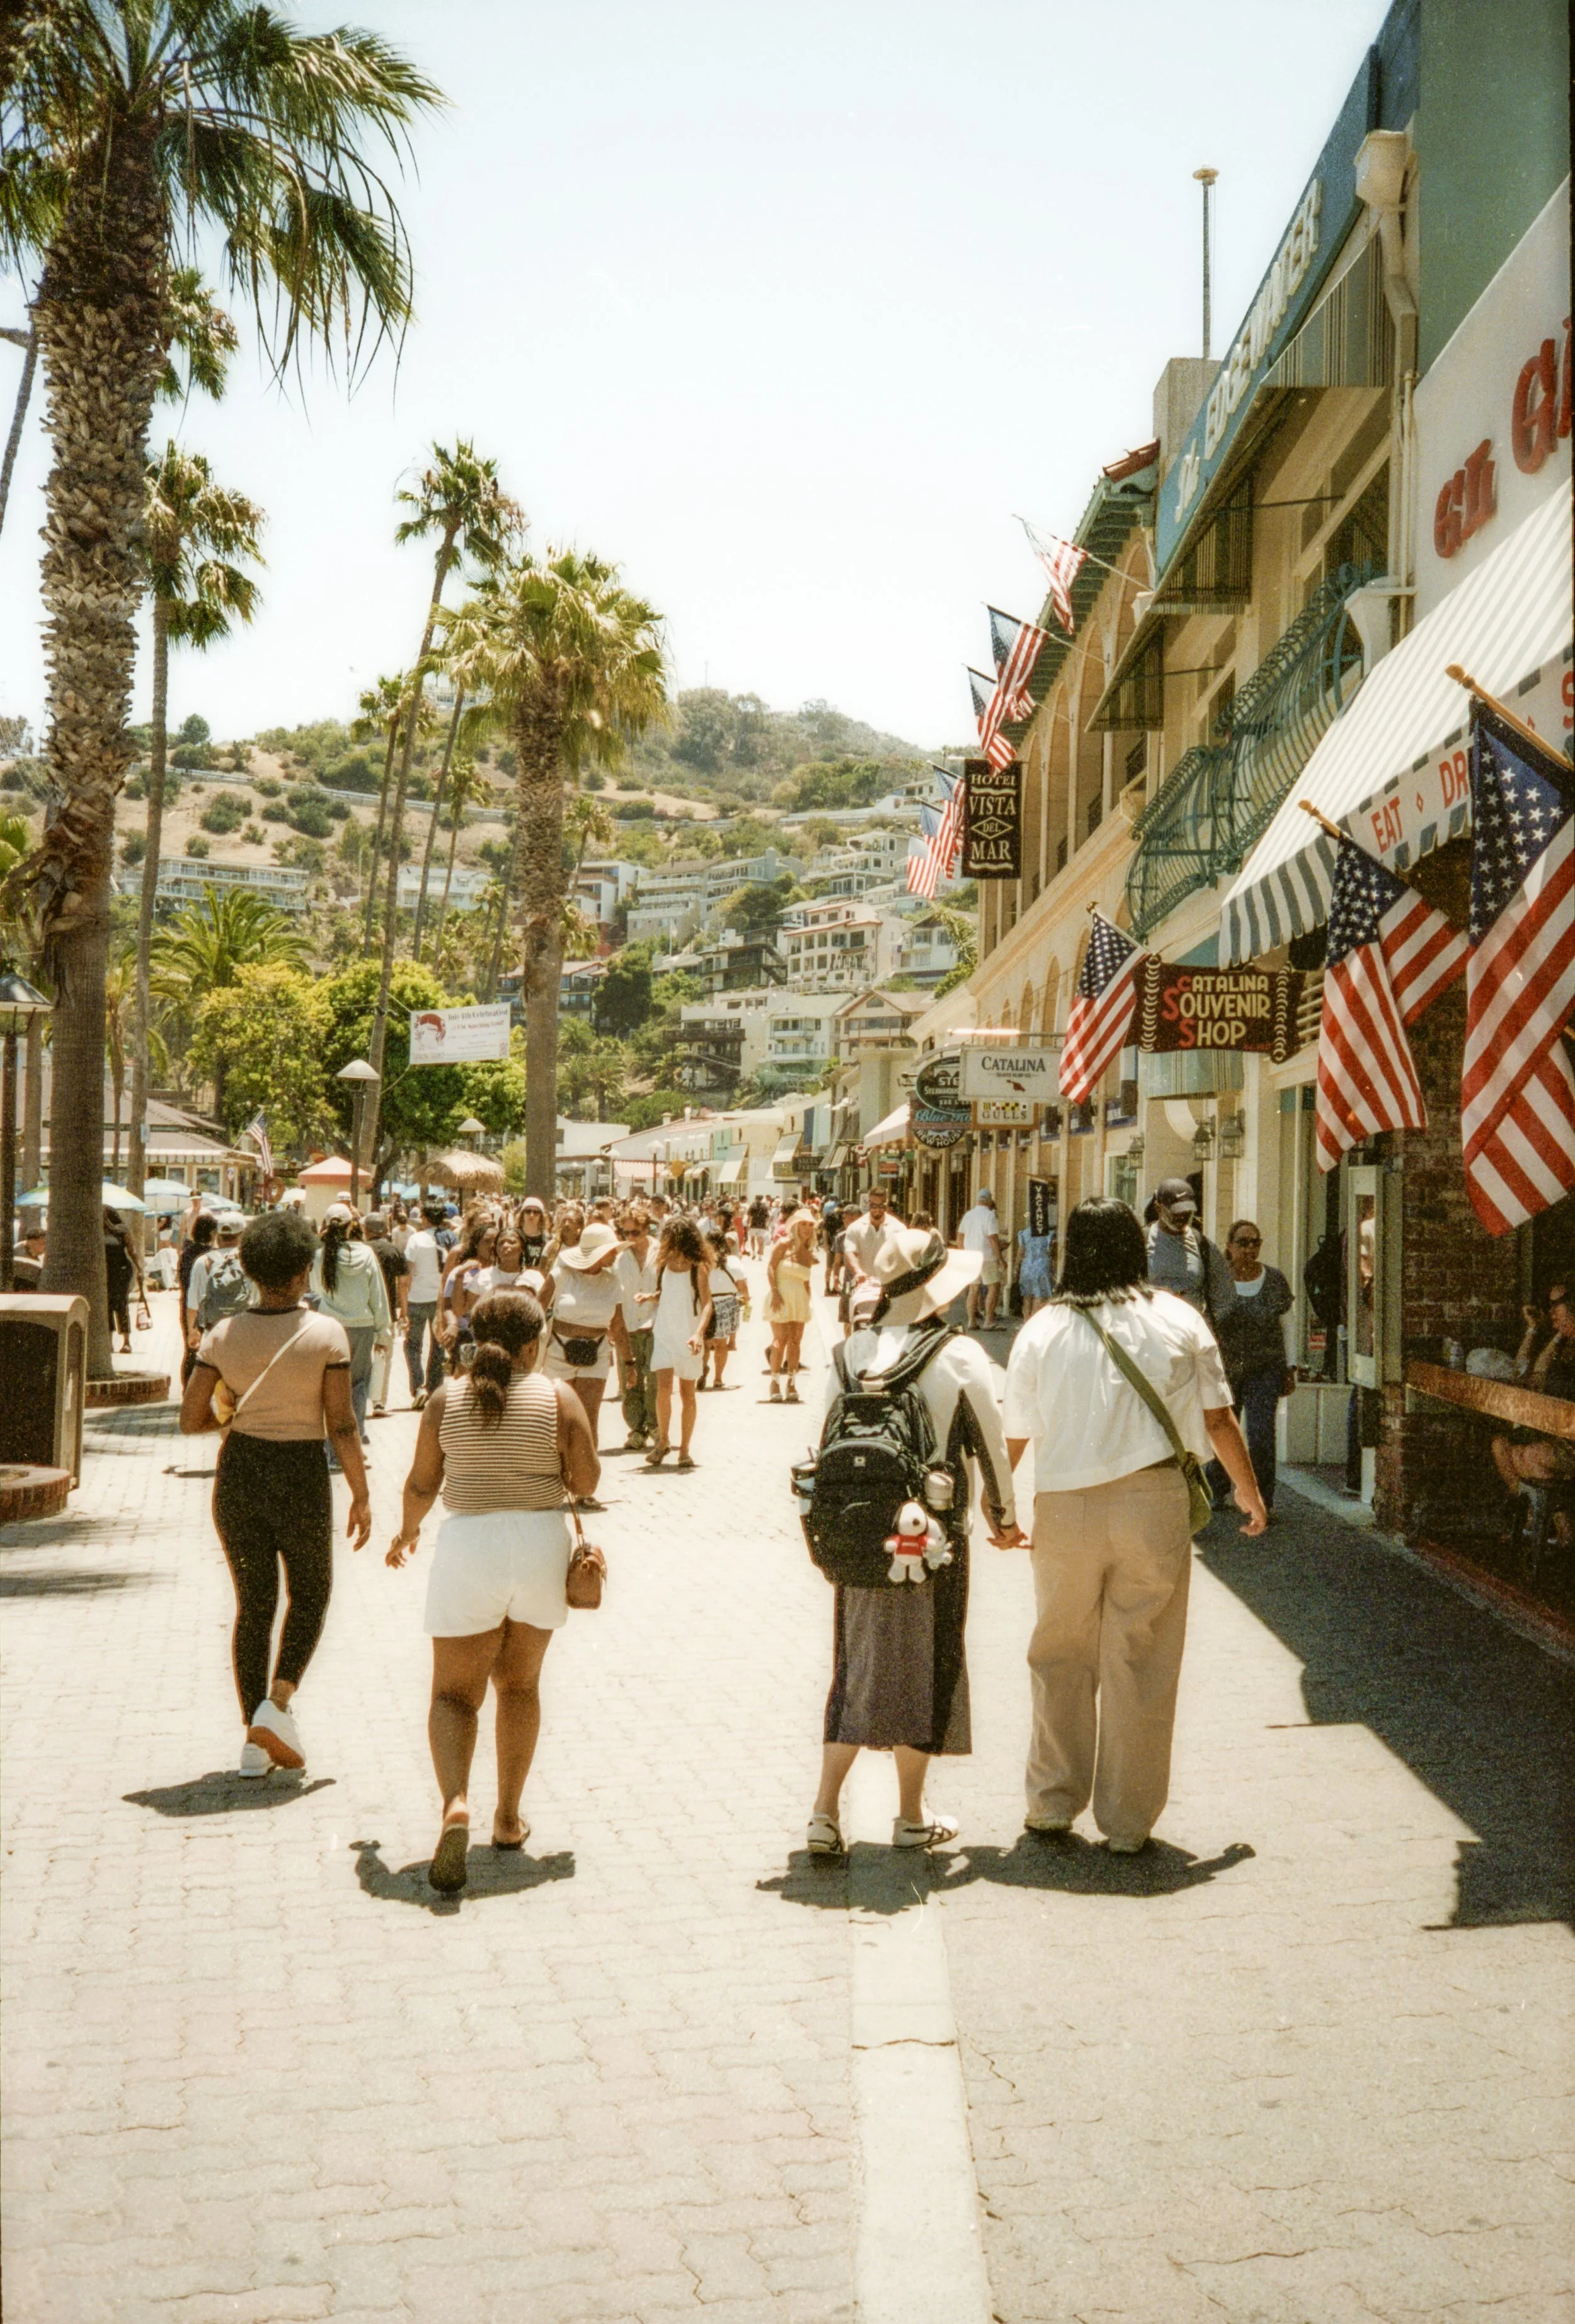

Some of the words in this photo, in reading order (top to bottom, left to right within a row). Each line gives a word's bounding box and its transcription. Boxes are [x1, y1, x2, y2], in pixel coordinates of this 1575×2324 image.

[971, 774, 1016, 786] HOTEL
[1438, 751, 1469, 809] DR
[969, 796, 1016, 815] VISTA
[983, 822, 1001, 832] DEL
[1370, 797, 1404, 854] EAT
[971, 841, 1012, 860] MAR
[1177, 975, 1269, 992] CATALINA
[1161, 987, 1271, 1021] SOUVENIR
[1177, 1018, 1247, 1049] SHOP
[982, 1056, 1046, 1072] CATALINA
[915, 1108, 947, 1122] Blue
[982, 1111, 1027, 1120] GULLS
[1035, 1185, 1044, 1234] VACANCY
